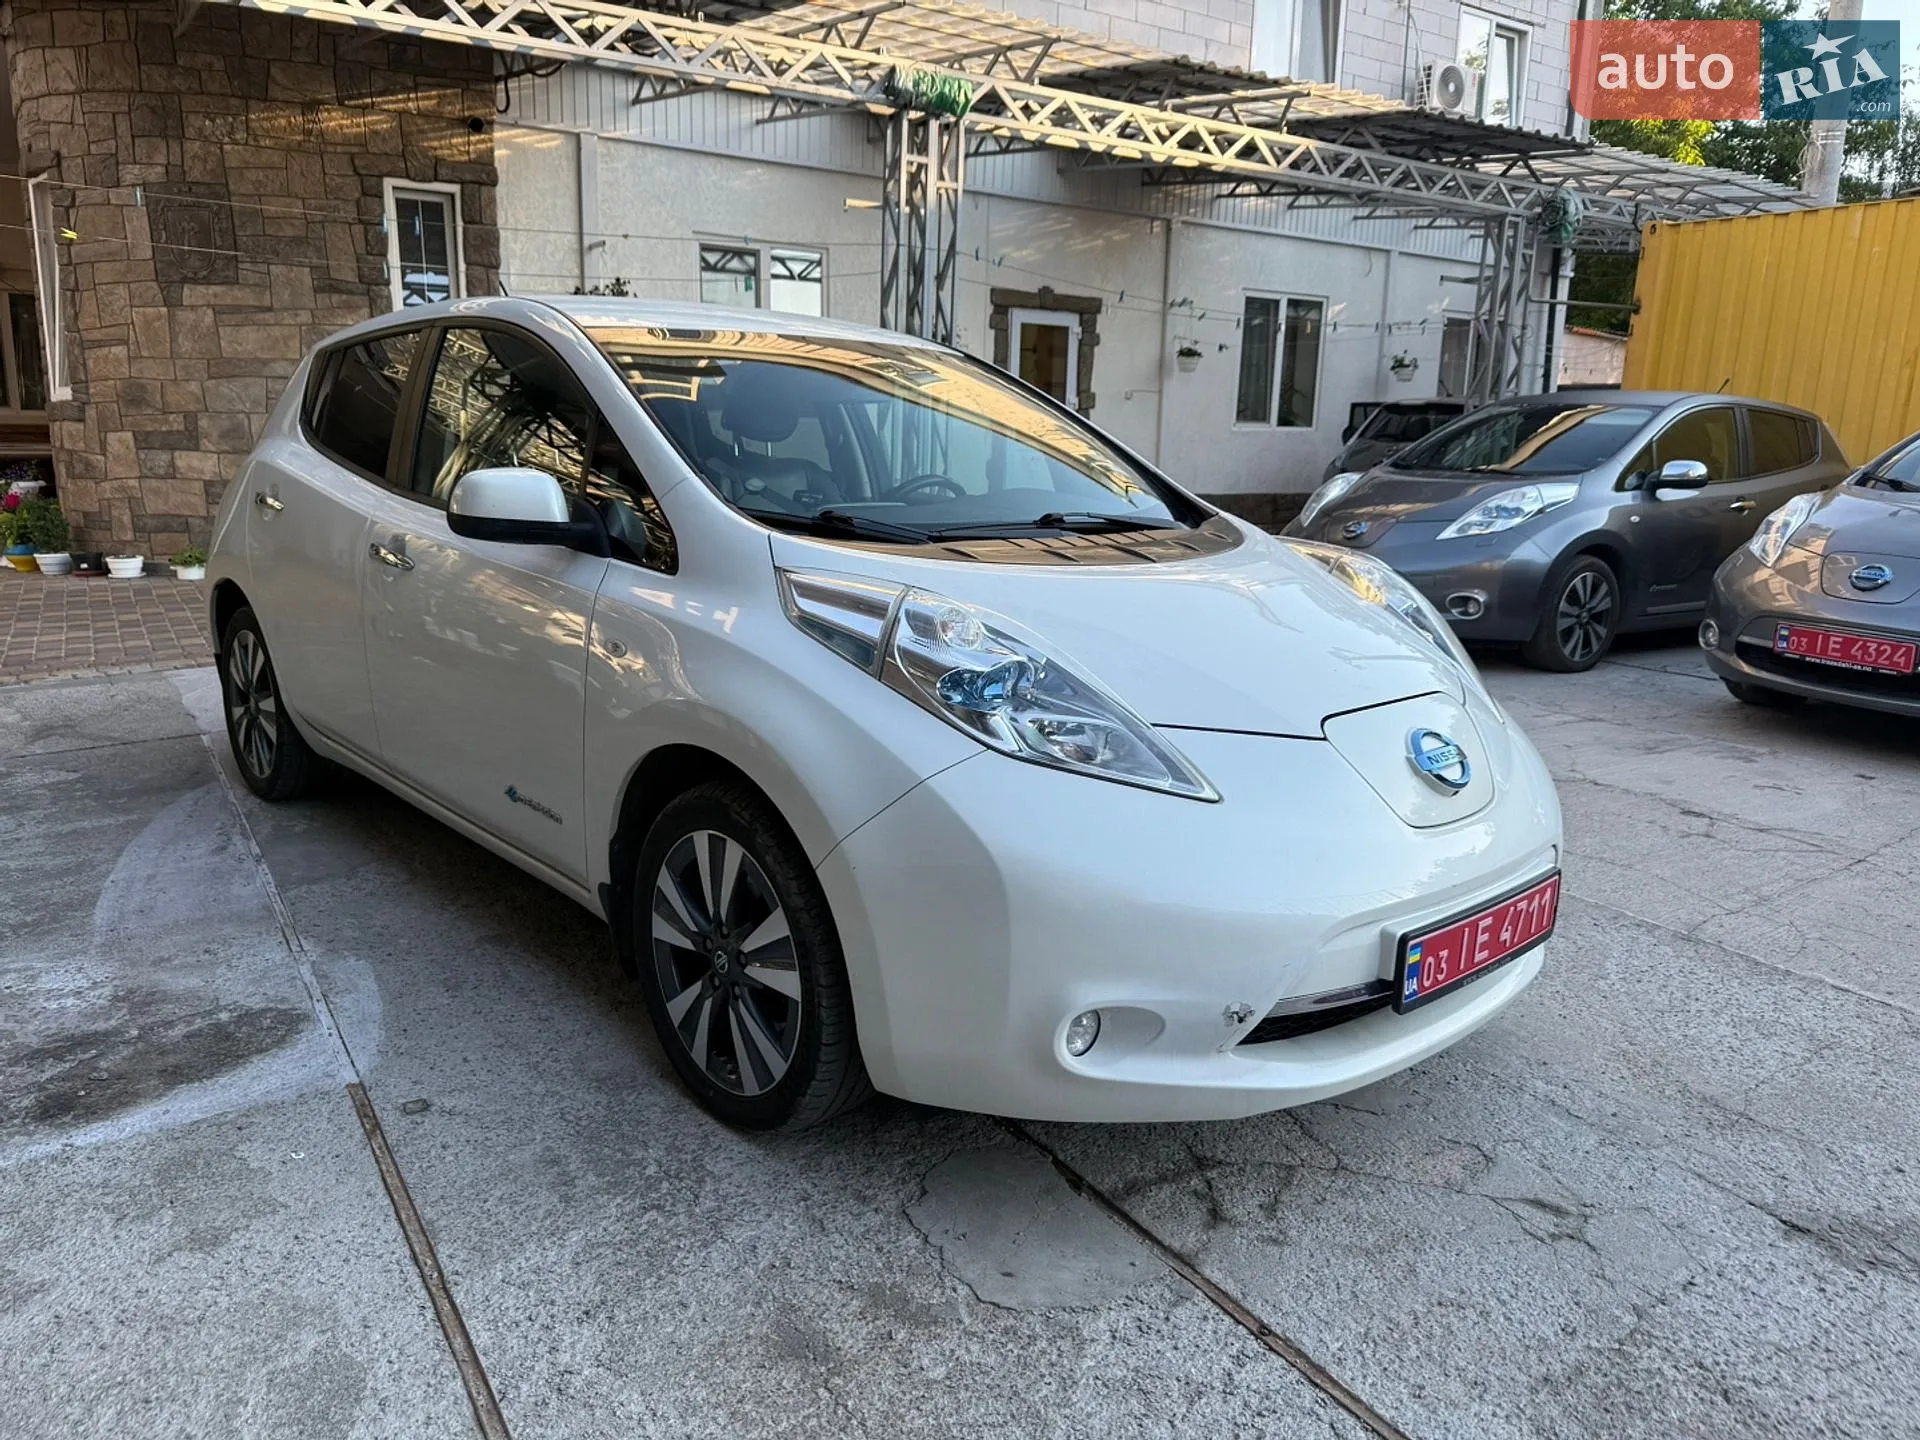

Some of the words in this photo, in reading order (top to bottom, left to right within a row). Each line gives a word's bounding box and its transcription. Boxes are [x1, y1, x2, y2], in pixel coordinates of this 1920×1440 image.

[1789, 636, 1808, 651] 03
[1816, 634, 1842, 657] IE
[1850, 641, 1906, 668] 4324
[1426, 748, 1458, 765] NISS
[1405, 976, 1418, 995] UA
[1422, 949, 1448, 988] 03
[1459, 917, 1493, 970] IE
[1499, 886, 1552, 948] 4711
